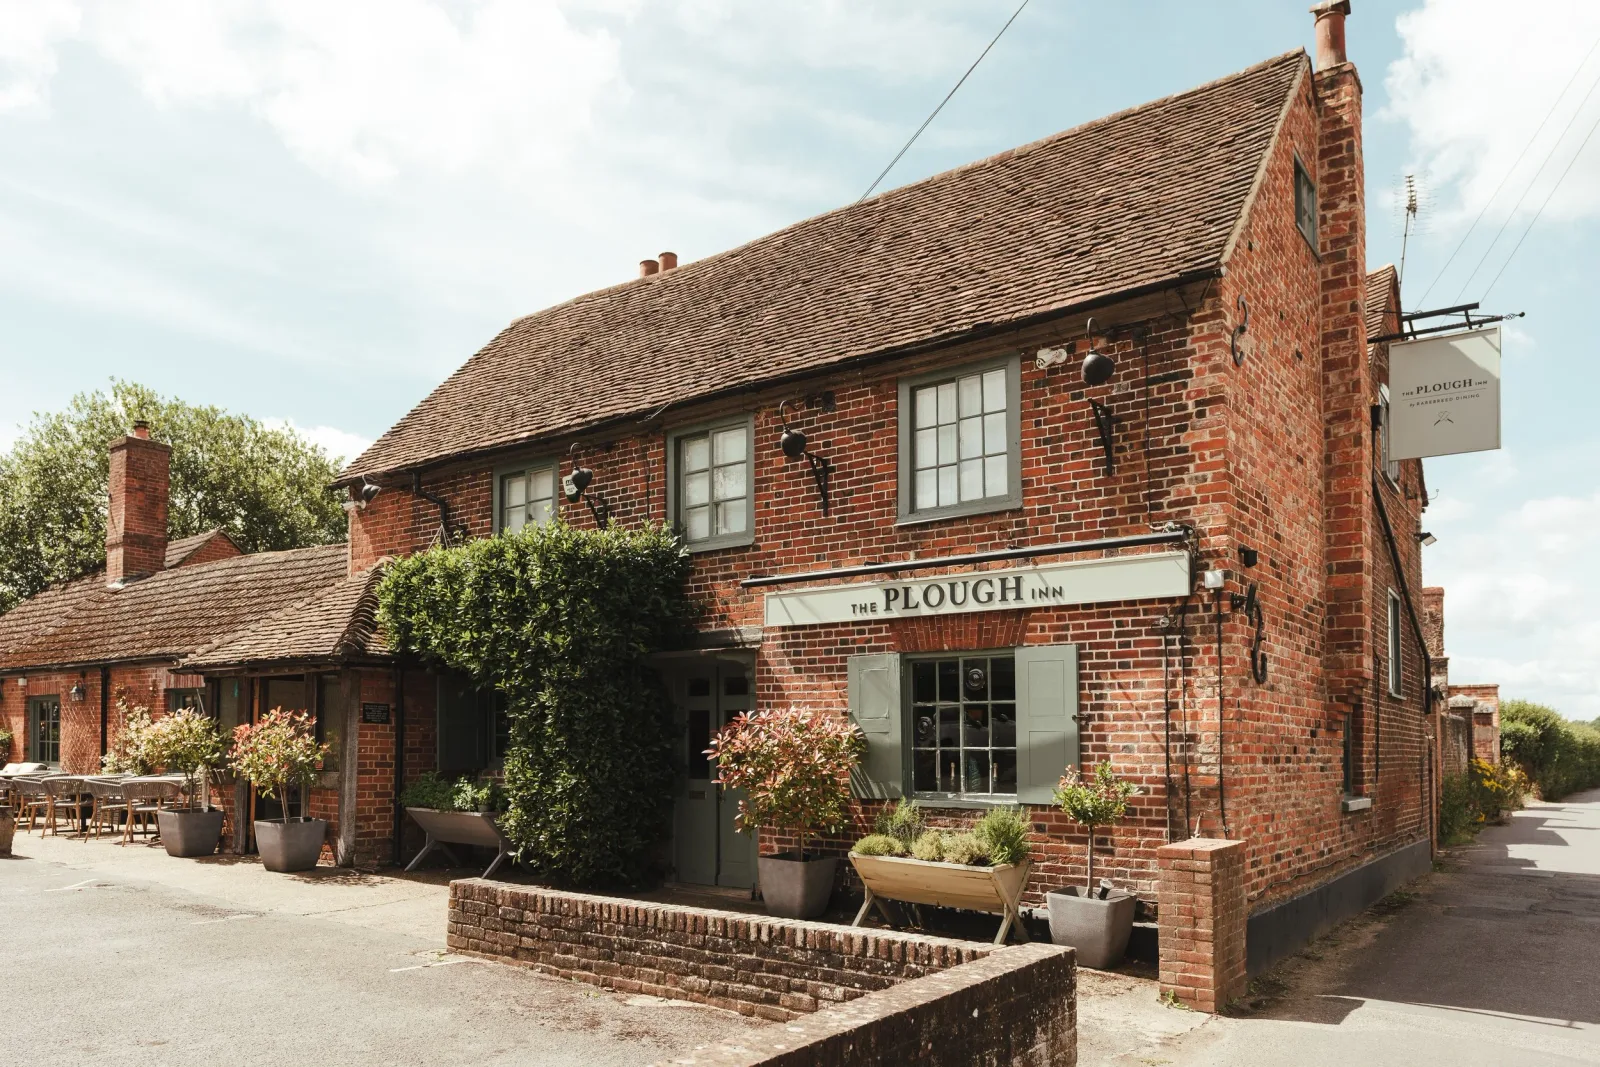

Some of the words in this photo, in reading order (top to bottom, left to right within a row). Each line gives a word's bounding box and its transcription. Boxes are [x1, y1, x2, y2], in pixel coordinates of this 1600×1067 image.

[1416, 379, 1472, 394] PLOUGH
[1416, 398, 1453, 406] RAREBREED
[851, 602, 877, 614] THE
[883, 575, 1023, 611] PLOUGH
[1031, 586, 1063, 600] INN
